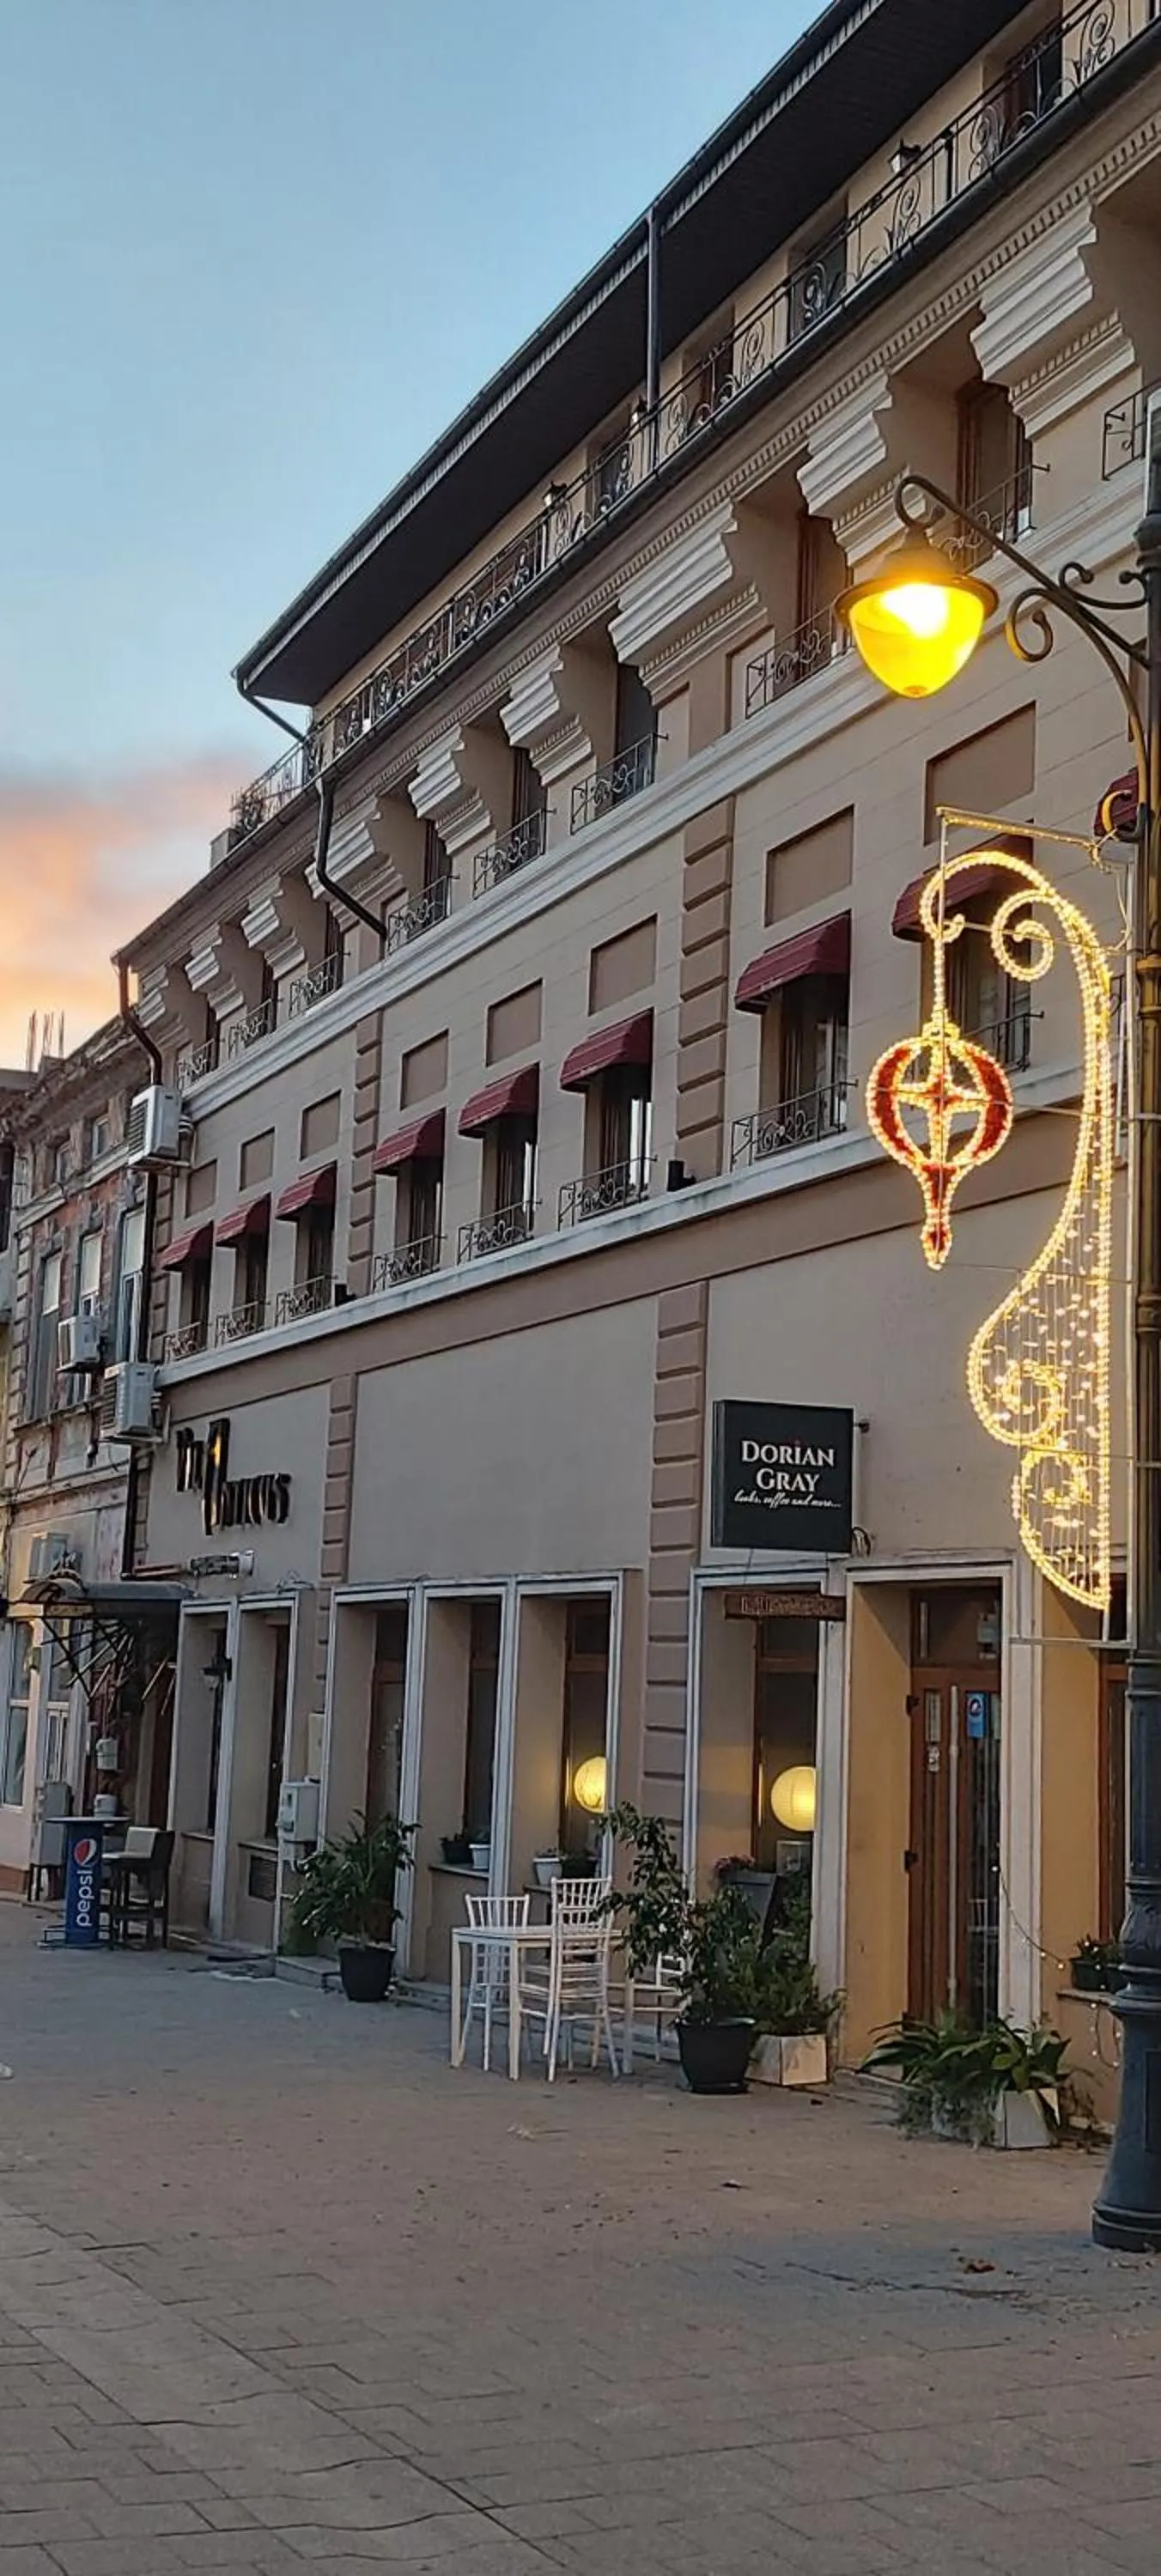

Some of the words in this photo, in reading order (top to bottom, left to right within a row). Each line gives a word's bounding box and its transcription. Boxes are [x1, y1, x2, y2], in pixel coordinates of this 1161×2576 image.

[741, 1439, 836, 1467] DORIAN
[757, 1467, 820, 1492] GRAY
[763, 1492, 791, 1509] coffee
[791, 1494, 814, 1506] and
[76, 1869, 95, 1927] pepsi
